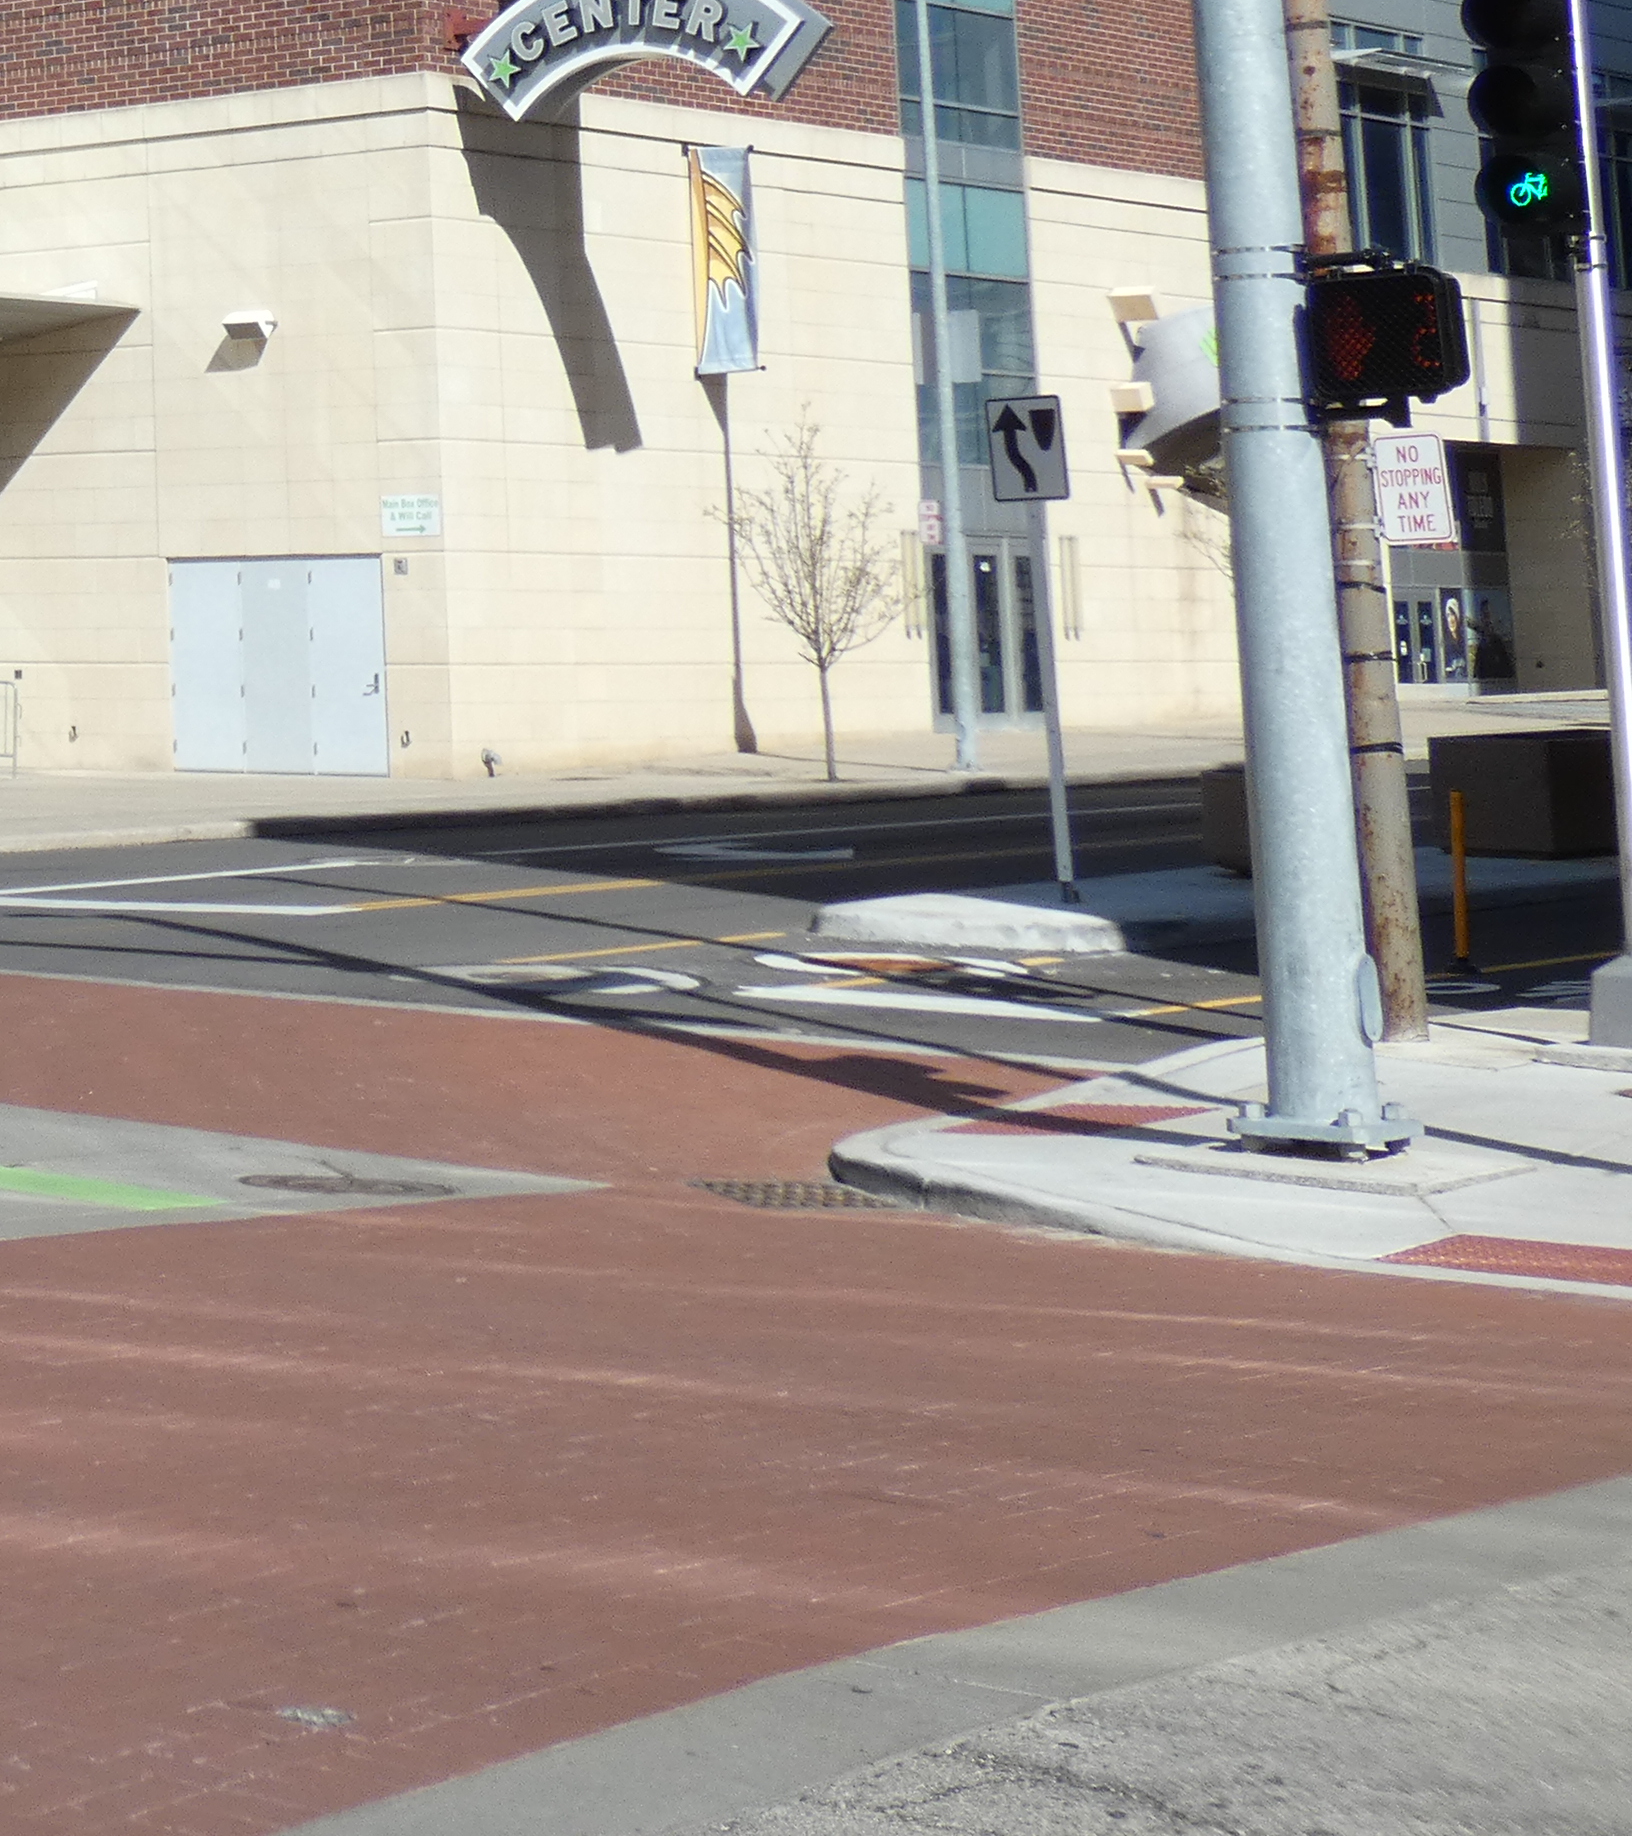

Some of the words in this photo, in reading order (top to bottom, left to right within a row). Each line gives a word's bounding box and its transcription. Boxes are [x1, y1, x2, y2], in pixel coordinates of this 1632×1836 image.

[1396, 445, 1419, 463] NO
[1380, 467, 1442, 488] STOPPING
[1397, 491, 1430, 510] ANY
[1397, 514, 1436, 533] TIME
